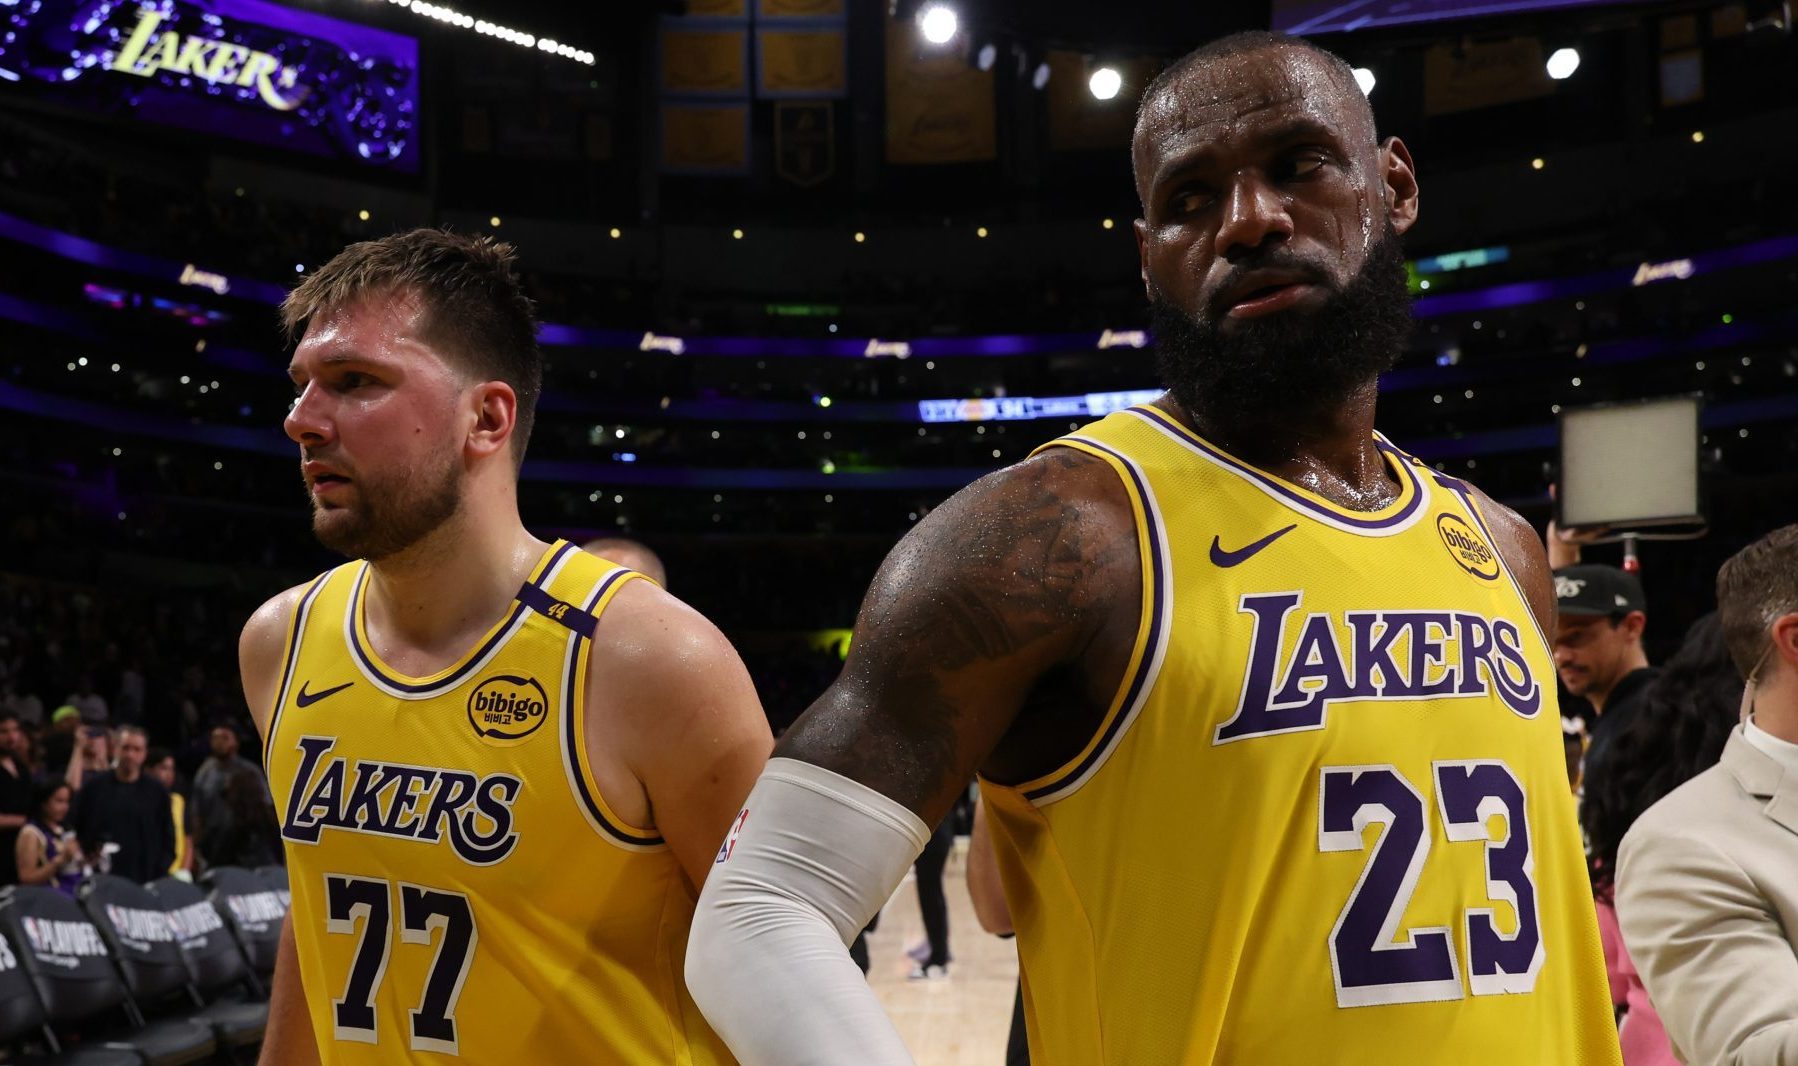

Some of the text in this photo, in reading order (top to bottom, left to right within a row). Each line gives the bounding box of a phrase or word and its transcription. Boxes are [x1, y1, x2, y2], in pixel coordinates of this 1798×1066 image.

[1441, 526, 1492, 563] bibigo
[548, 603, 570, 620] 44
[475, 691, 543, 721] bibigo
[1212, 590, 1541, 746] LAKERS
[484, 712, 512, 725] 비비고
[281, 736, 523, 867] LAKERS
[1318, 759, 1547, 1008] 23
[324, 872, 479, 1056] 77
